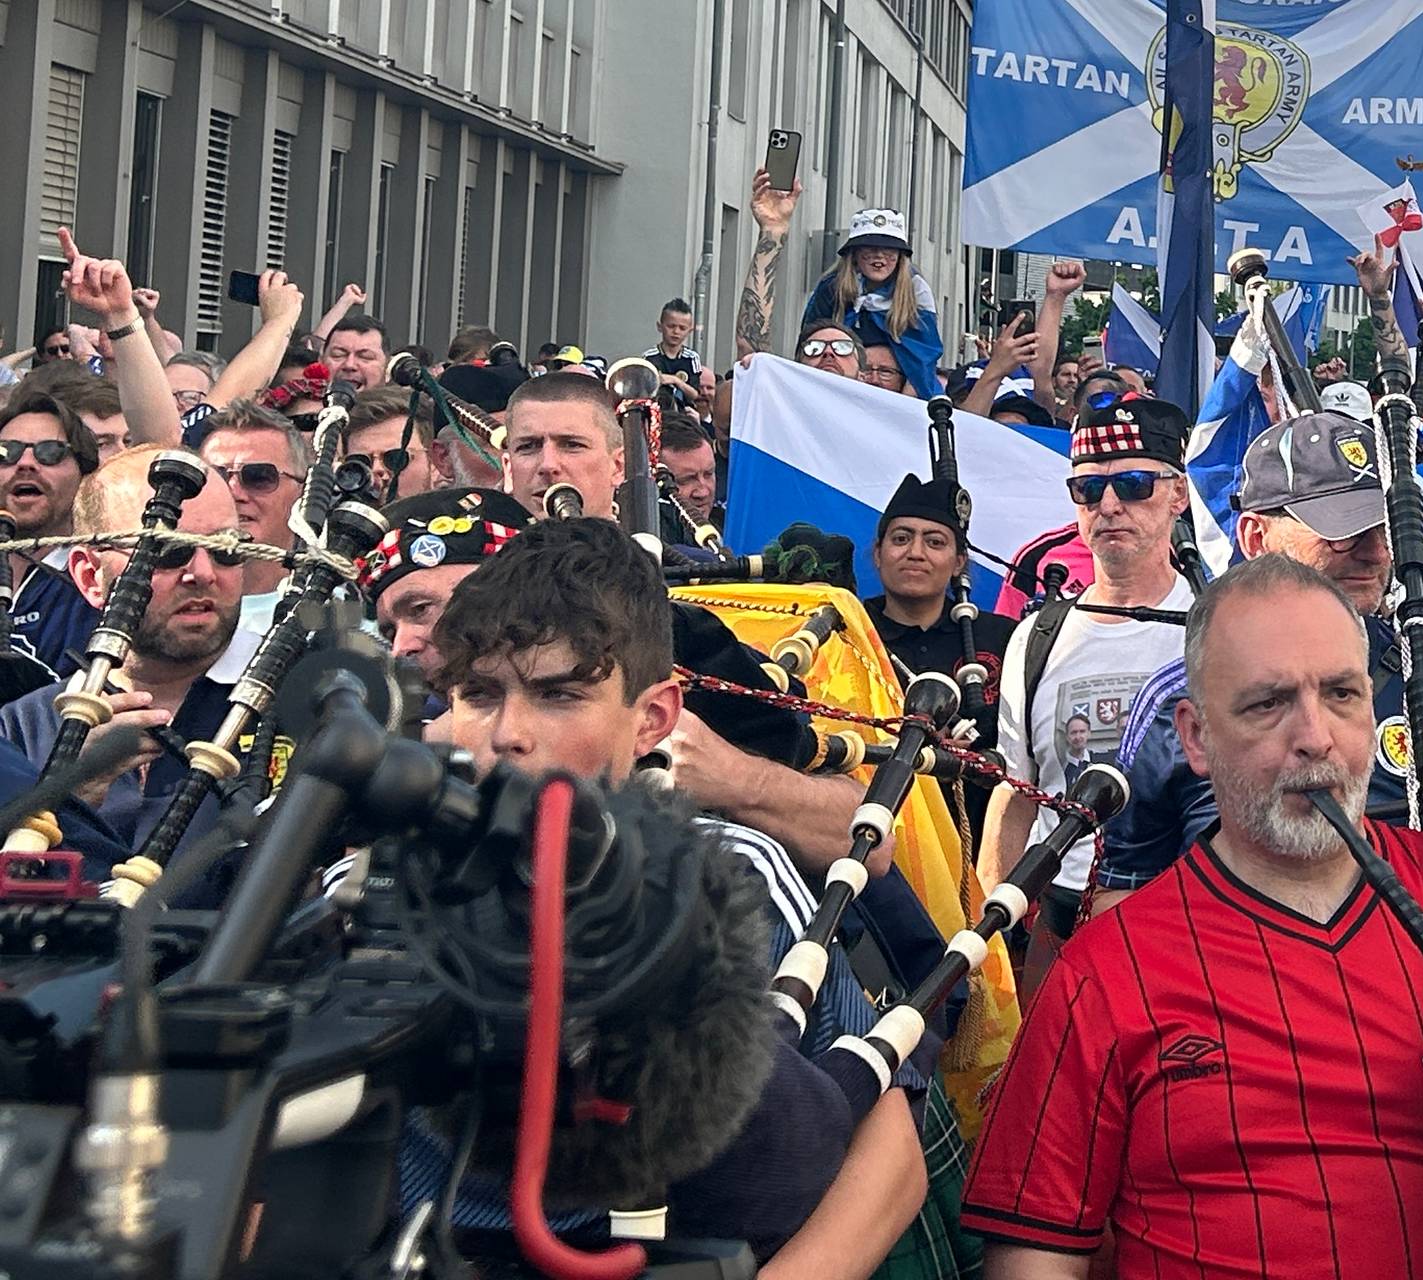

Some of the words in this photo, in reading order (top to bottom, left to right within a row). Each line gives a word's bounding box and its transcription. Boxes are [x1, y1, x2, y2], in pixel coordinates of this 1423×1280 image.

[971, 47, 1130, 98] TARTAN
[1228, 27, 1299, 67] TARTAN
[1276, 72, 1302, 125] ARMY
[1170, 1061, 1221, 1082] umbro
